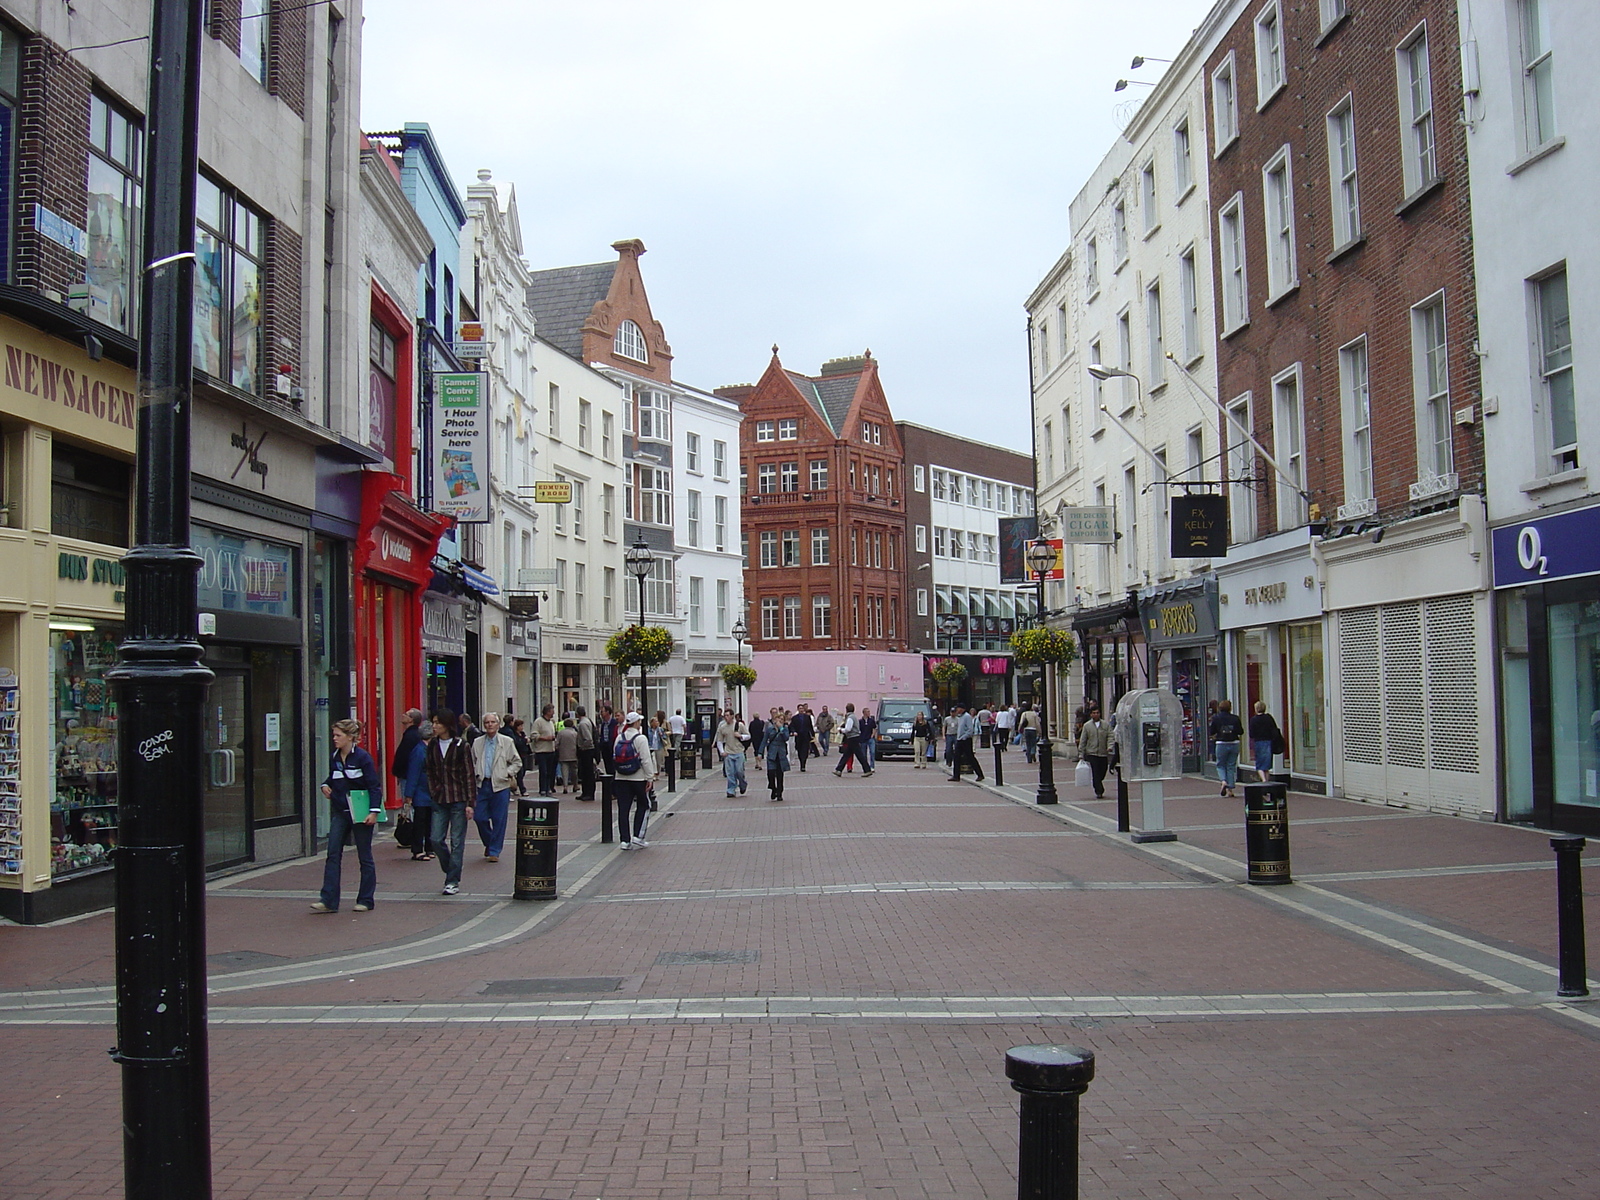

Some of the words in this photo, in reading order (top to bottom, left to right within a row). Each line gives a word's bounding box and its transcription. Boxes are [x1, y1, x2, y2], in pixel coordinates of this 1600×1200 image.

[5, 344, 135, 430] NEWSAGEN
[444, 409, 449, 417] 1
[452, 409, 477, 417] Hour
[445, 419, 475, 427] Photo
[441, 429, 479, 437] Service
[448, 439, 471, 447] here
[1069, 520, 1109, 530] CIGAR
[1184, 521, 1214, 531] KELLY
[1070, 530, 1109, 538] EMPORIUM
[389, 536, 411, 563] vodafone
[59, 552, 88, 581] BUS
[240, 554, 275, 597] SHOP
